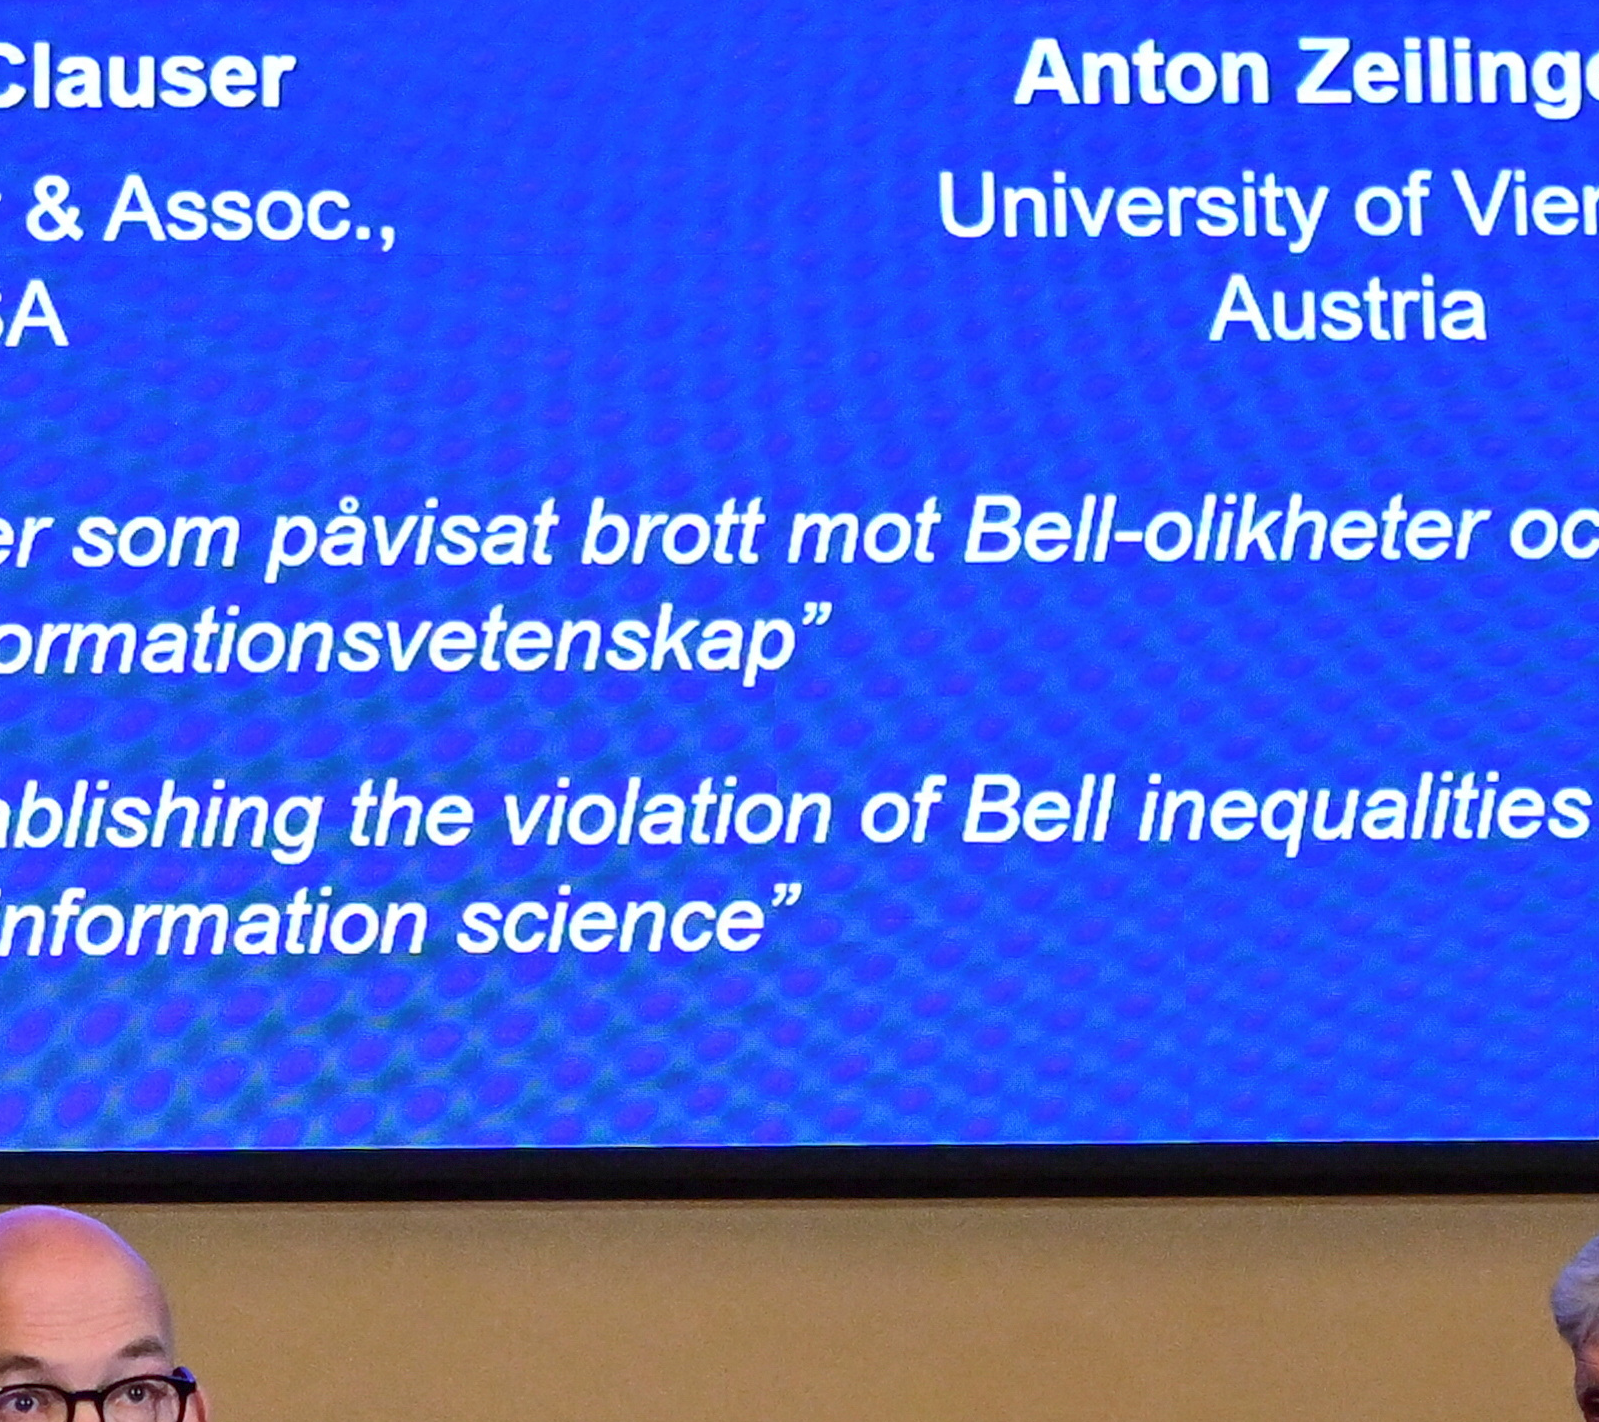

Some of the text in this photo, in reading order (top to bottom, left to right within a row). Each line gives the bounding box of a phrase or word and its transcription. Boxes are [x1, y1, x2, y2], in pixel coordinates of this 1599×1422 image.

[1015, 39, 1268, 104] Anton
[27, 175, 83, 241] &
[104, 175, 394, 251] Assoc.,
[940, 171, 1328, 253] University
[1356, 170, 1431, 235] of
[1210, 274, 1486, 340] Austria
[73, 517, 239, 566] som
[265, 497, 559, 583] påvisat
[582, 498, 765, 564] brott
[789, 497, 941, 562] mot
[965, 494, 1491, 562] Bell-olikheter
[351, 778, 473, 846] the
[505, 776, 831, 845] violation
[862, 775, 946, 842] of
[963, 774, 1115, 842] Bell
[1139, 772, 1592, 857] inequalities
